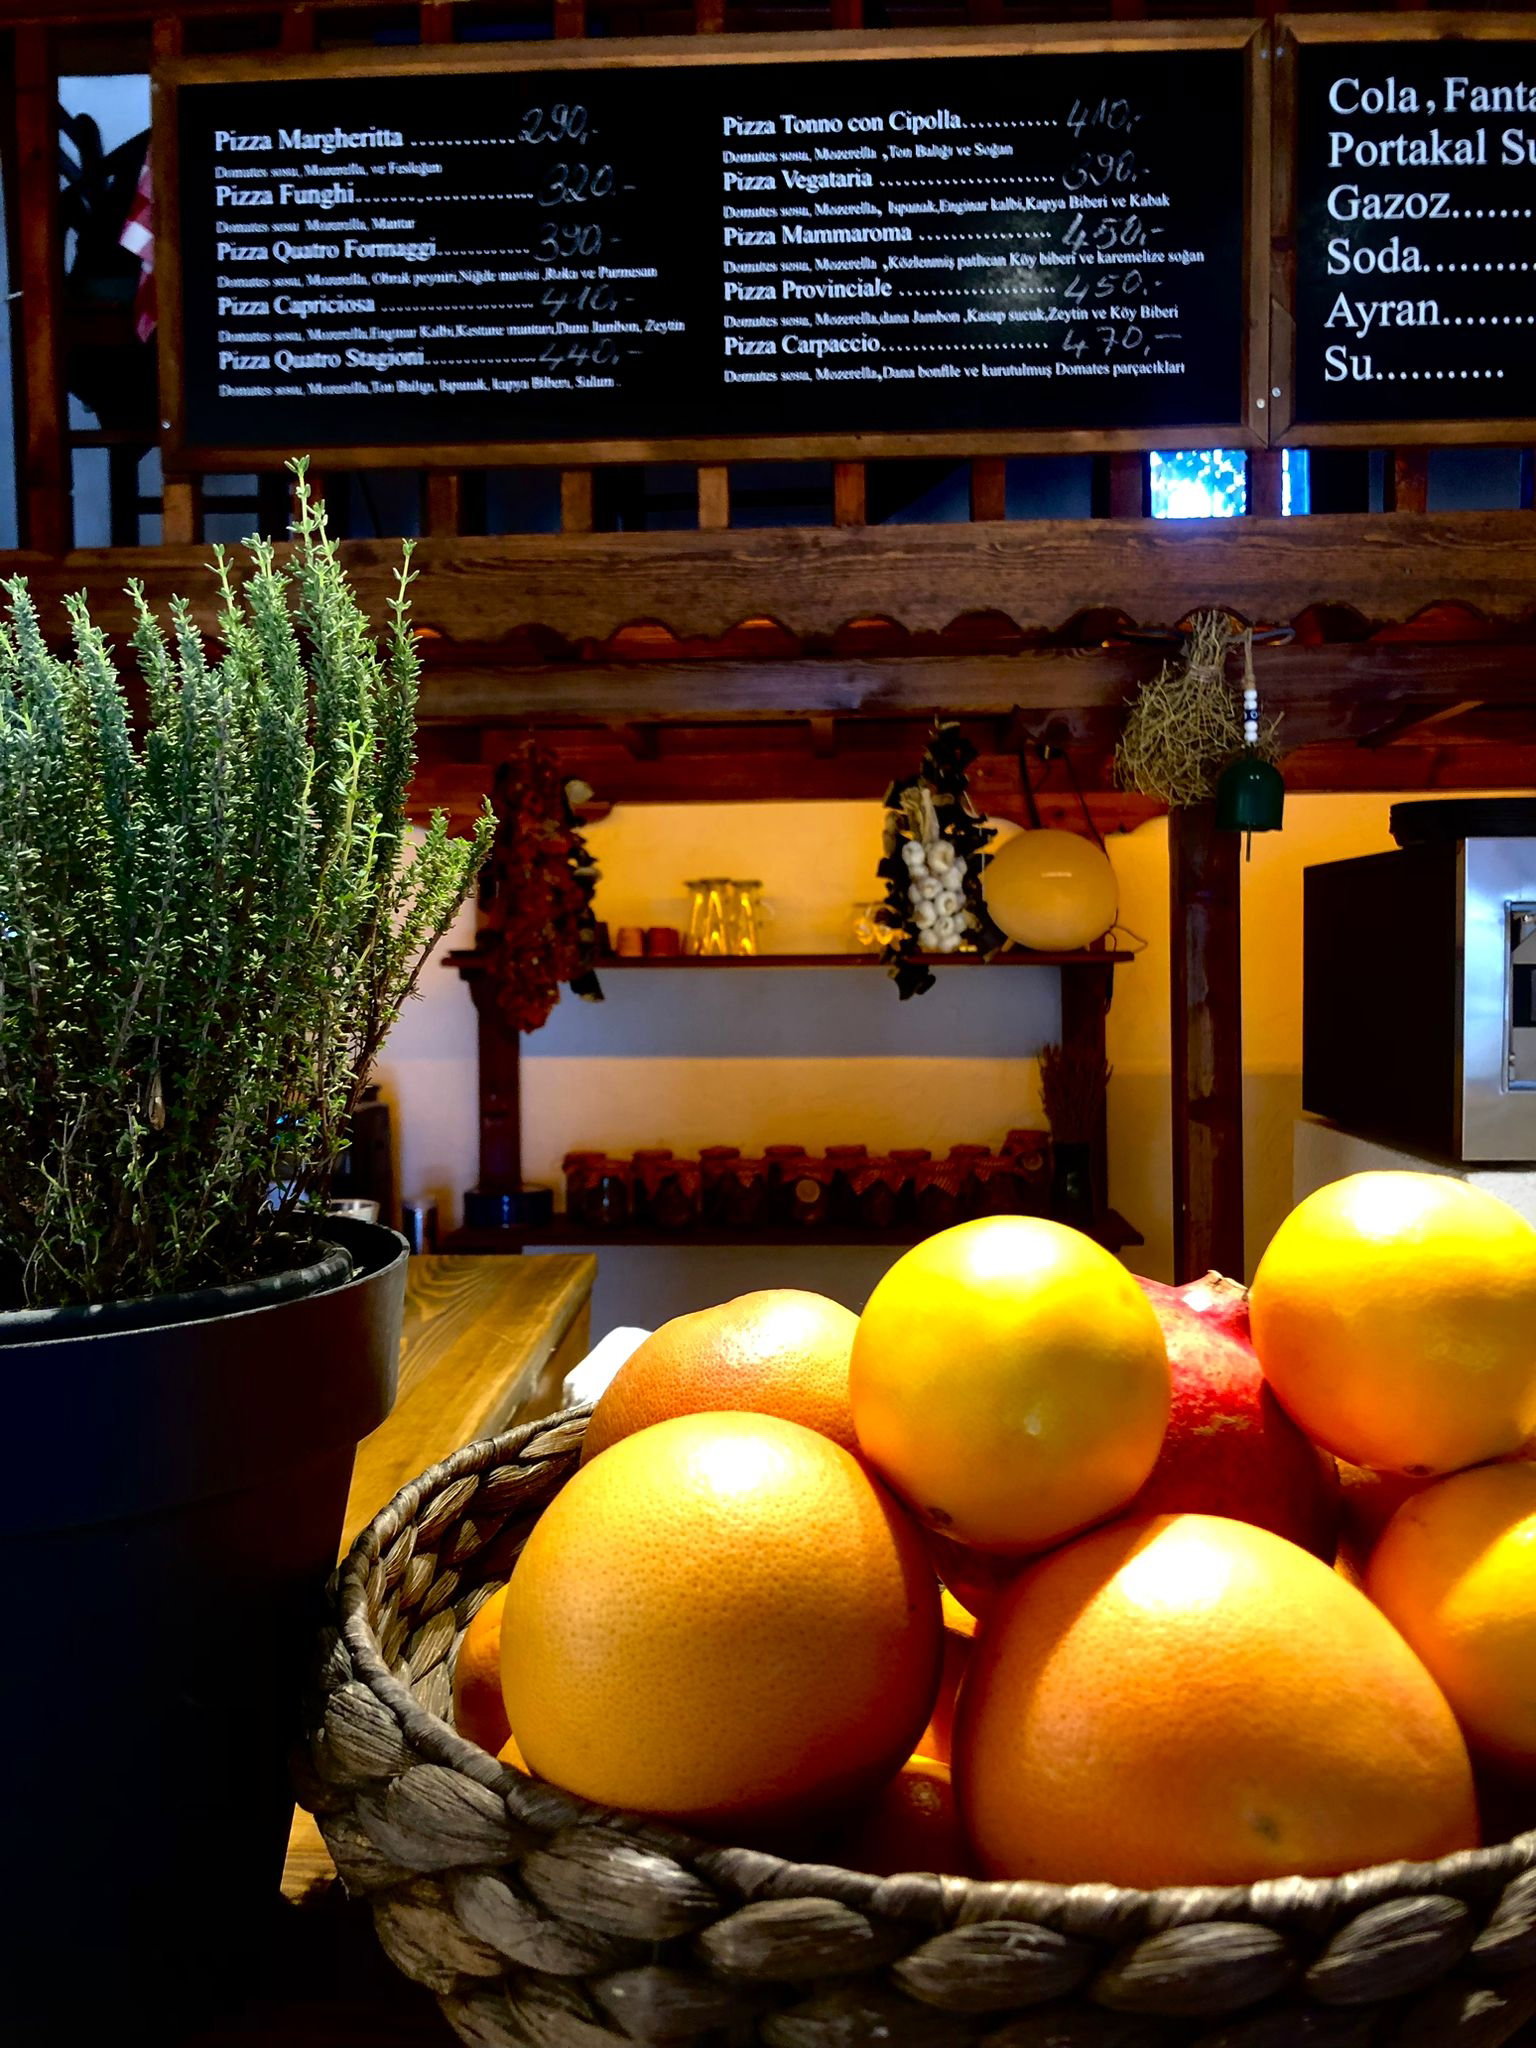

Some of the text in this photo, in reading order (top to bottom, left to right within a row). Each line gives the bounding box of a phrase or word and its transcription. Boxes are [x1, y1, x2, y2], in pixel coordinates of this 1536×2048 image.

[723, 116, 776, 136] Pizza
[780, 114, 843, 134] Tonno
[847, 117, 884, 132] con
[888, 109, 960, 135] Cipolla
[215, 131, 273, 151] Pizza
[278, 127, 404, 154] Margheritta
[1328, 128, 1488, 167] Portakal
[723, 151, 778, 163] Domates
[956, 146, 972, 156] ve
[723, 171, 776, 191] Pizza
[781, 168, 873, 193] Vegataria
[215, 185, 274, 206] Pizza
[279, 182, 354, 209] Funghi
[723, 206, 778, 218] Domates
[1111, 198, 1127, 207] ve
[1130, 193, 1170, 207] Kabak
[724, 227, 776, 246] Pizza
[782, 225, 913, 244] Mammaroma
[216, 242, 269, 261] Pizza
[272, 241, 339, 264] Quatro
[344, 238, 436, 261] Formaggi
[723, 261, 778, 273] Domates
[1009, 252, 1036, 269] Köy
[1079, 254, 1095, 264] ve
[1168, 250, 1204, 265] soğan
[724, 282, 777, 301] Pizza
[782, 277, 892, 299] Provinciale
[218, 297, 270, 315] Pizza
[273, 295, 375, 319] Capriciosa
[724, 316, 778, 328] Domates
[1091, 309, 1107, 319] ve
[1110, 306, 1137, 322] Köy
[1141, 305, 1179, 318] Biberi
[724, 336, 777, 355] Pizza
[782, 333, 880, 358] Carpaccio
[219, 351, 271, 370] Pizza
[273, 350, 342, 372] Quatro
[345, 347, 424, 371] Stagioni
[724, 370, 778, 382] Domates
[964, 367, 980, 377] ve
[1056, 362, 1110, 375] Domates
